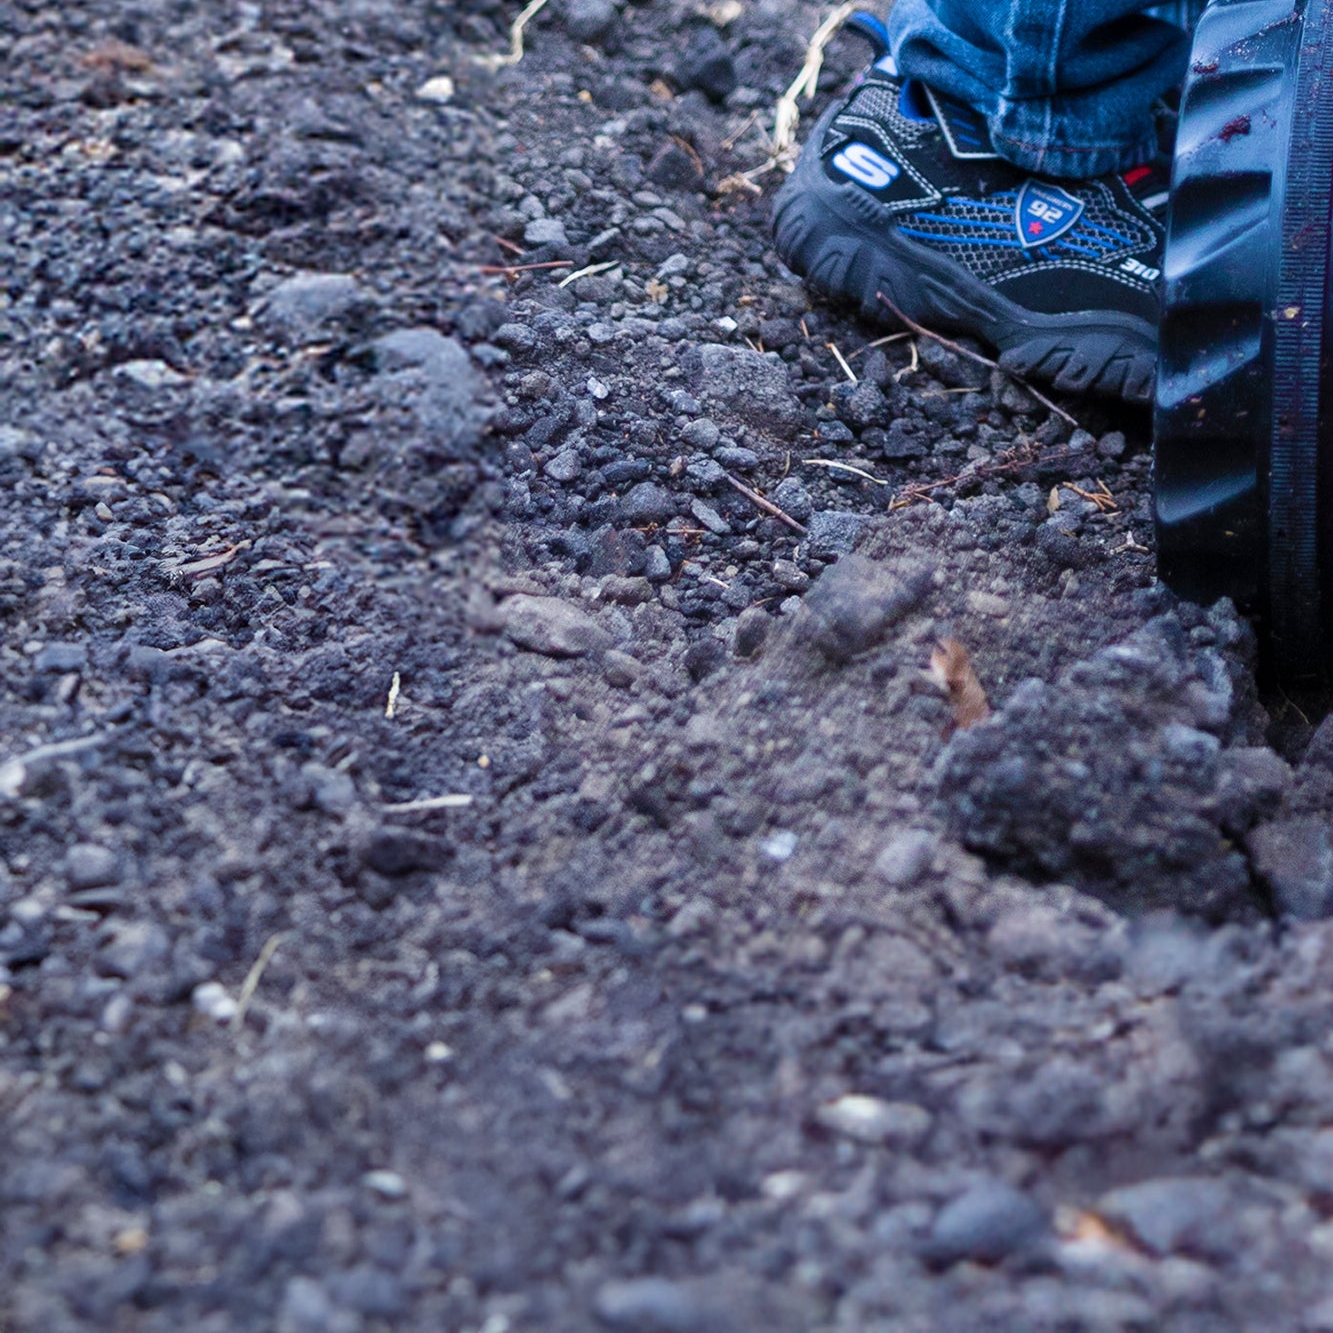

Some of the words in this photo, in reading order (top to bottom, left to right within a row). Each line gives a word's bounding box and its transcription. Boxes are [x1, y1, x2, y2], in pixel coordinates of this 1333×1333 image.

[832, 142, 900, 190] S
[1027, 199, 1064, 225] 92
[1119, 256, 1161, 281] 310
